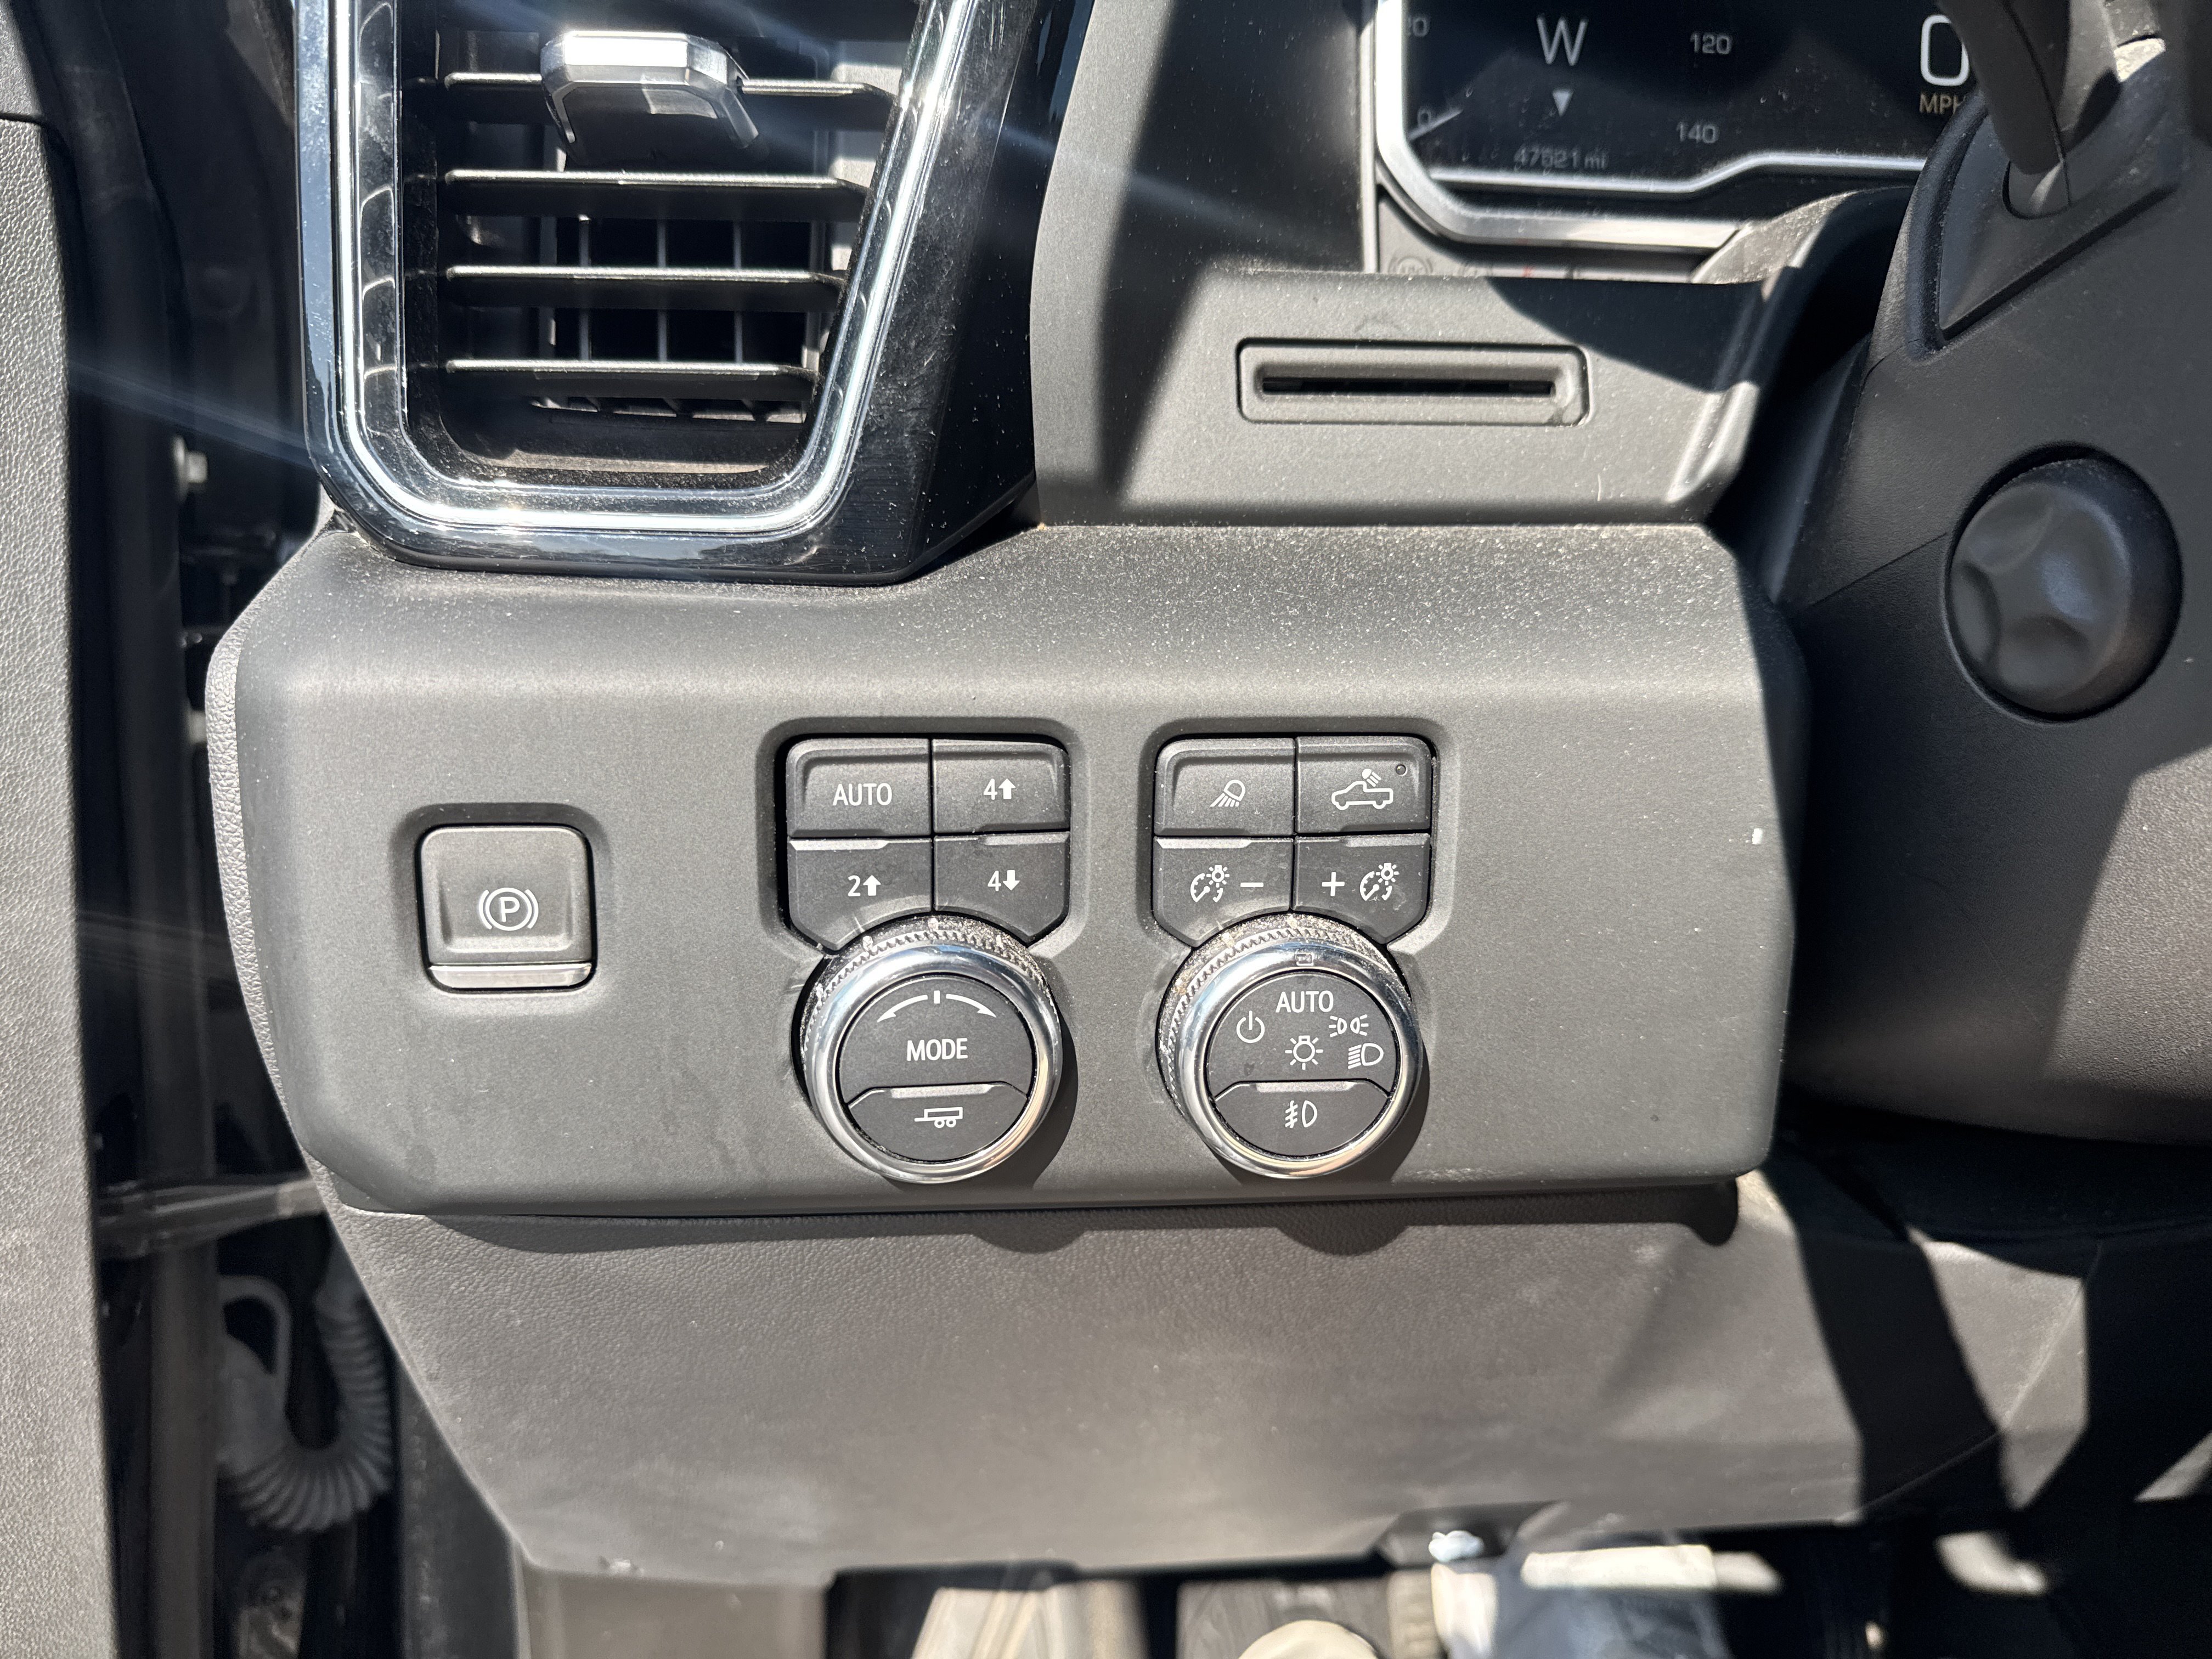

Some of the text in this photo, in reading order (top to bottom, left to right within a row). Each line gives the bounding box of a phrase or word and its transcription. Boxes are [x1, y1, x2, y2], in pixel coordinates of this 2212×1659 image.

[1536, 17, 1587, 66] W
[1691, 32, 1732, 54] 120
[1920, 14, 1970, 87] 0
[1677, 121, 1719, 144] 140
[832, 782, 893, 806] AUTO
[983, 778, 998, 800] 4
[848, 874, 861, 897] 2
[988, 870, 1002, 891] 4
[499, 896, 521, 923] P
[1276, 990, 1334, 1013] AUTO
[906, 1037, 968, 1062] MODE
